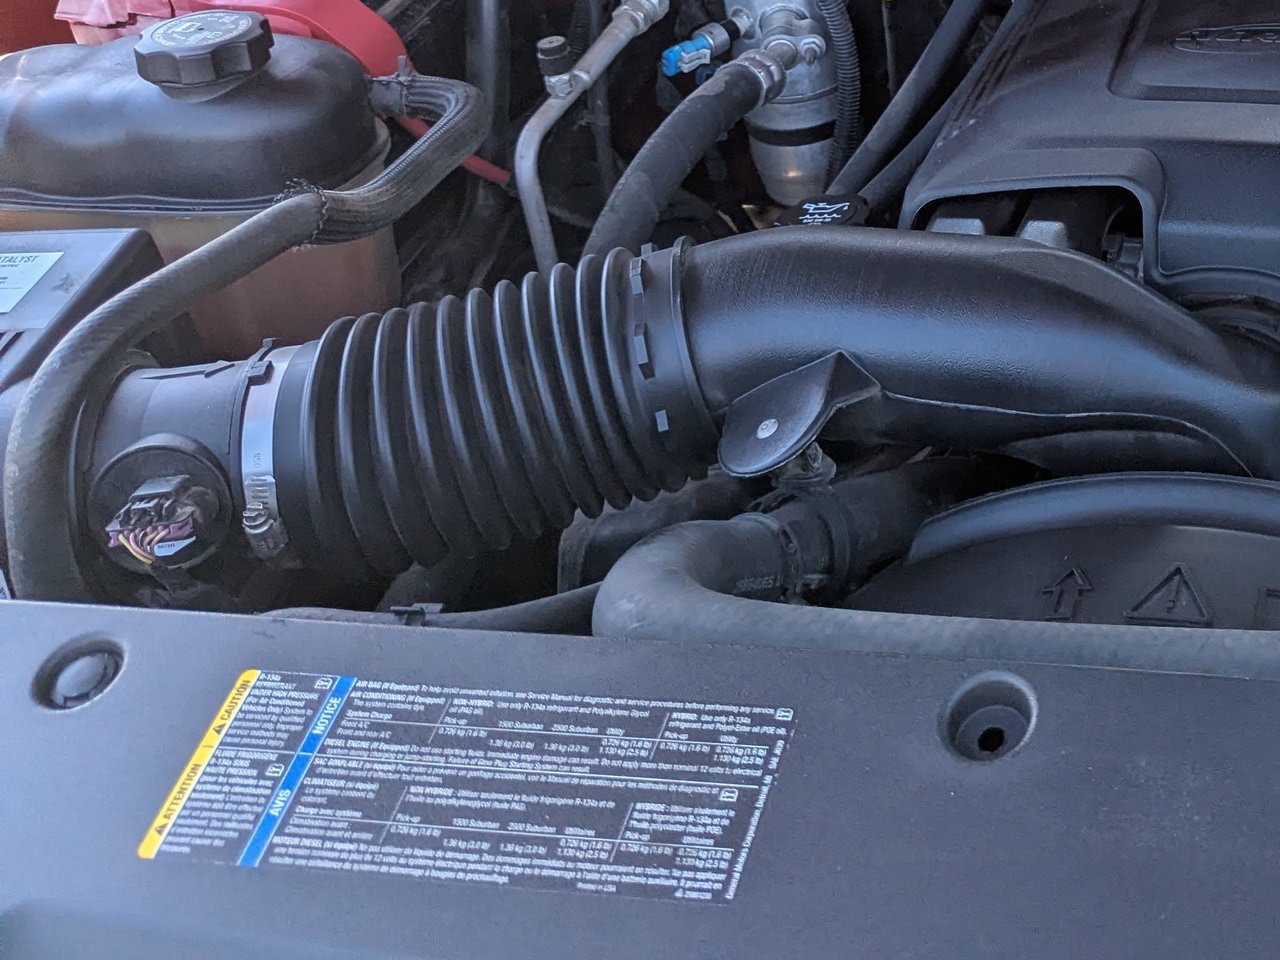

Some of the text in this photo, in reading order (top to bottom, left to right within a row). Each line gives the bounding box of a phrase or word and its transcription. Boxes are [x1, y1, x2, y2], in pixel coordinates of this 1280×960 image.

[219, 680, 251, 720] CAUTION
[311, 697, 341, 733] NOTICE
[161, 764, 203, 819] ATTENTION
[267, 790, 291, 815] AVIS
